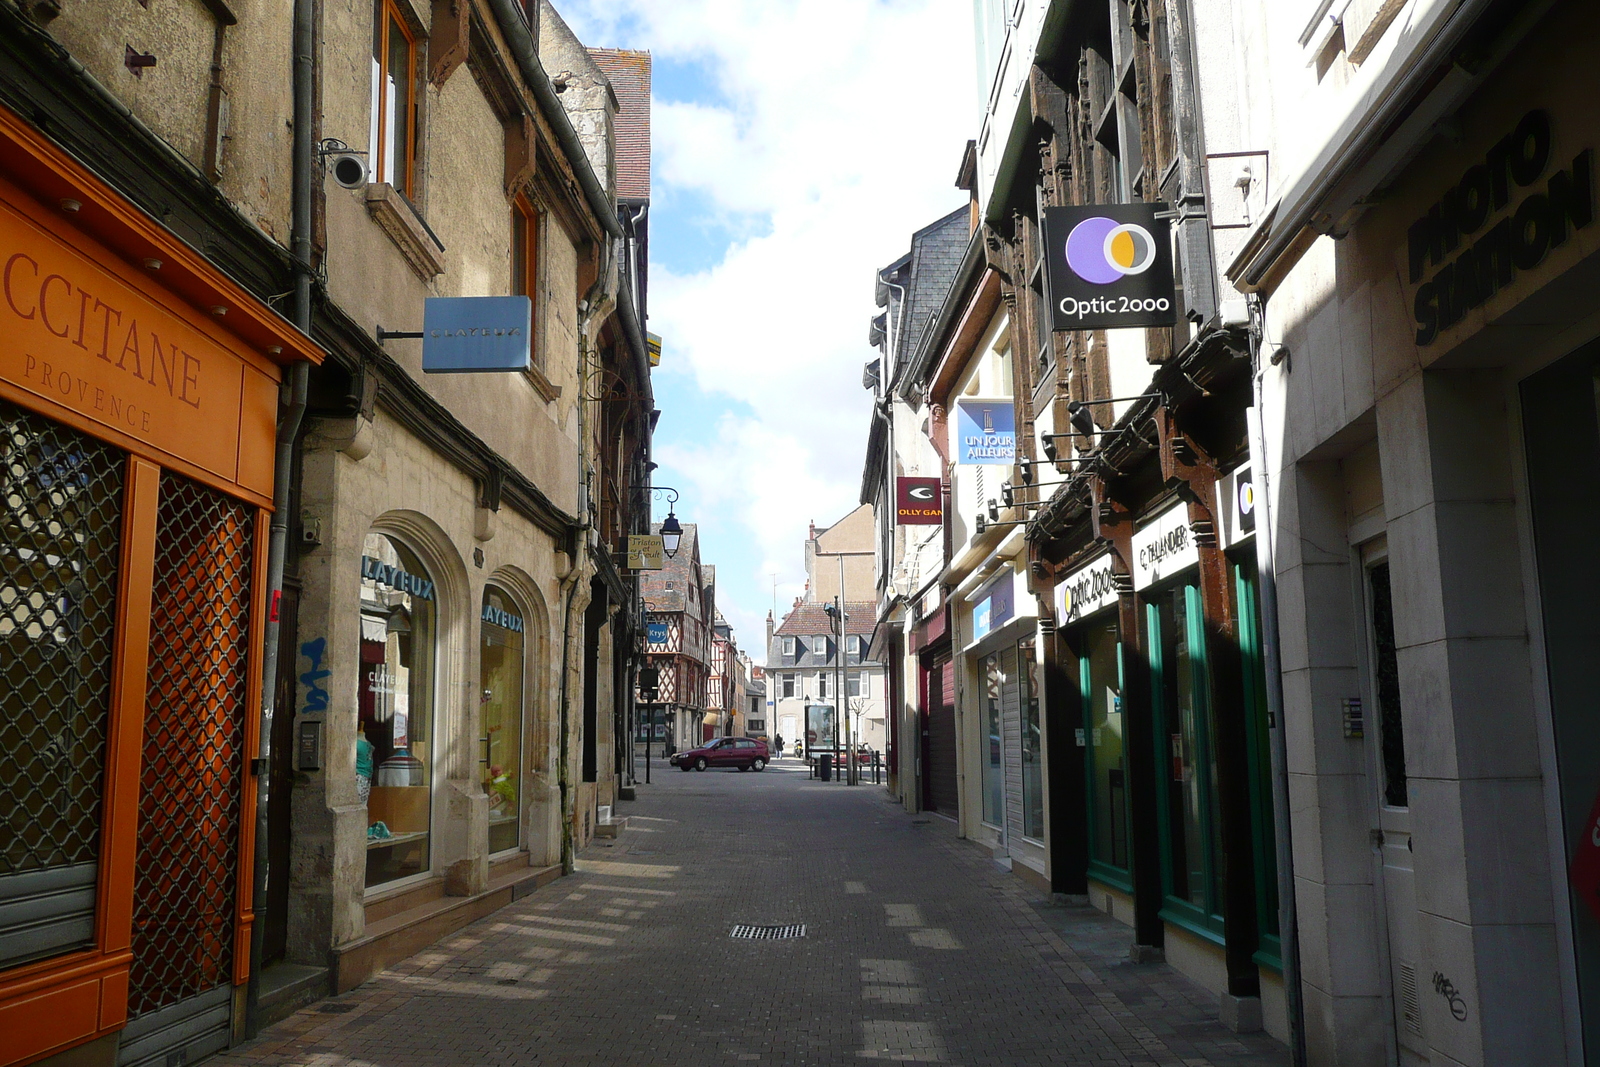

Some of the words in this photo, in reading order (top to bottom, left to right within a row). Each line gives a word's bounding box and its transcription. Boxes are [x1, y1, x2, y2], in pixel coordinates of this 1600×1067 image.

[1407, 109, 1549, 285] PHOTO
[1414, 148, 1592, 346] STATION
[1060, 296, 1116, 320] Optic
[1119, 297, 1170, 313] 2000
[430, 327, 520, 338] CLAYEUX
[24, 353, 150, 433] PROVENCE
[965, 436, 982, 447] UN
[983, 435, 1013, 448] JOUR
[967, 448, 1014, 459] AILLEURS
[481, 605, 523, 633] AYEUX
[650, 629, 665, 638] Krys
